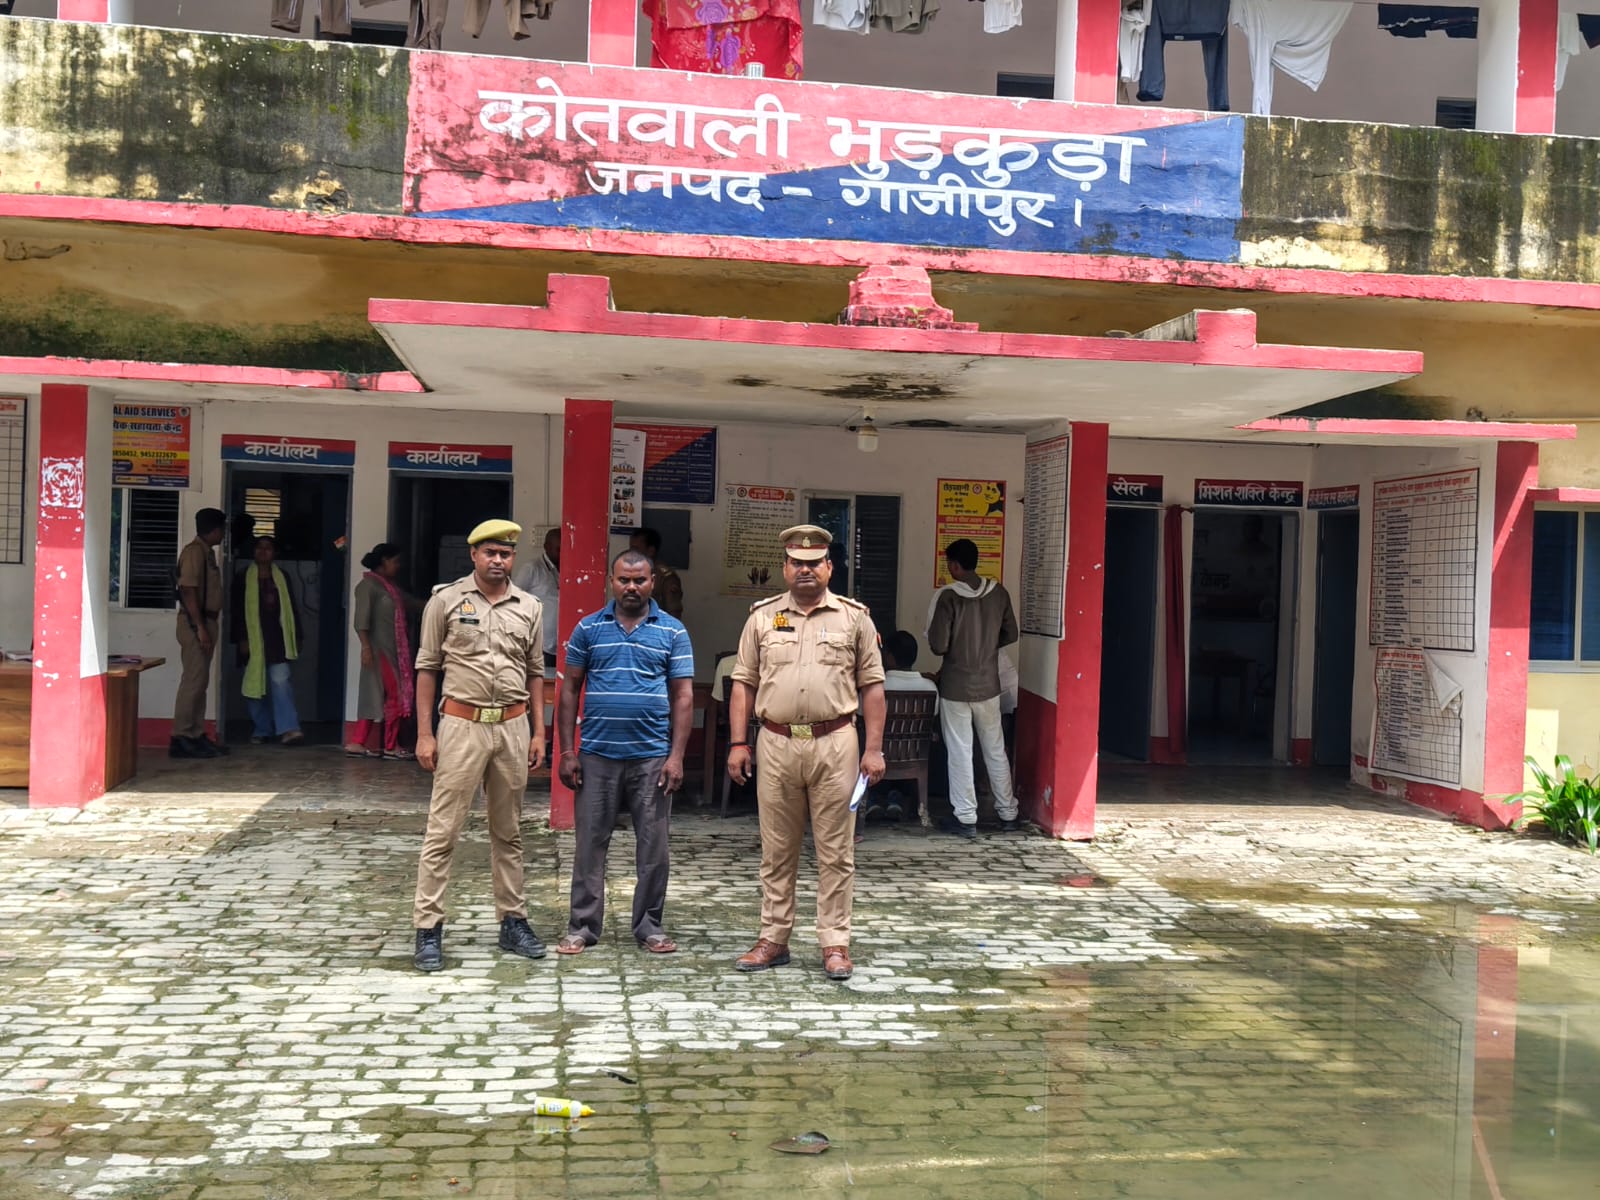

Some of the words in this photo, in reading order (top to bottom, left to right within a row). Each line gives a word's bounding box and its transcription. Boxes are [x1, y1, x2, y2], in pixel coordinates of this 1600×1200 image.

[477, 76, 801, 159] कोतवाली
[826, 117, 1148, 192] भुड़कुड़ा
[585, 161, 768, 212] जनपद
[839, 173, 1057, 237] गाजीपुर
[124, 406, 139, 416] AID
[141, 407, 176, 417] SERVIES
[244, 438, 322, 460] कार्यालय
[406, 445, 482, 467] कार्यालय
[1112, 477, 1149, 497] सेल
[1198, 481, 1234, 501] मिशन
